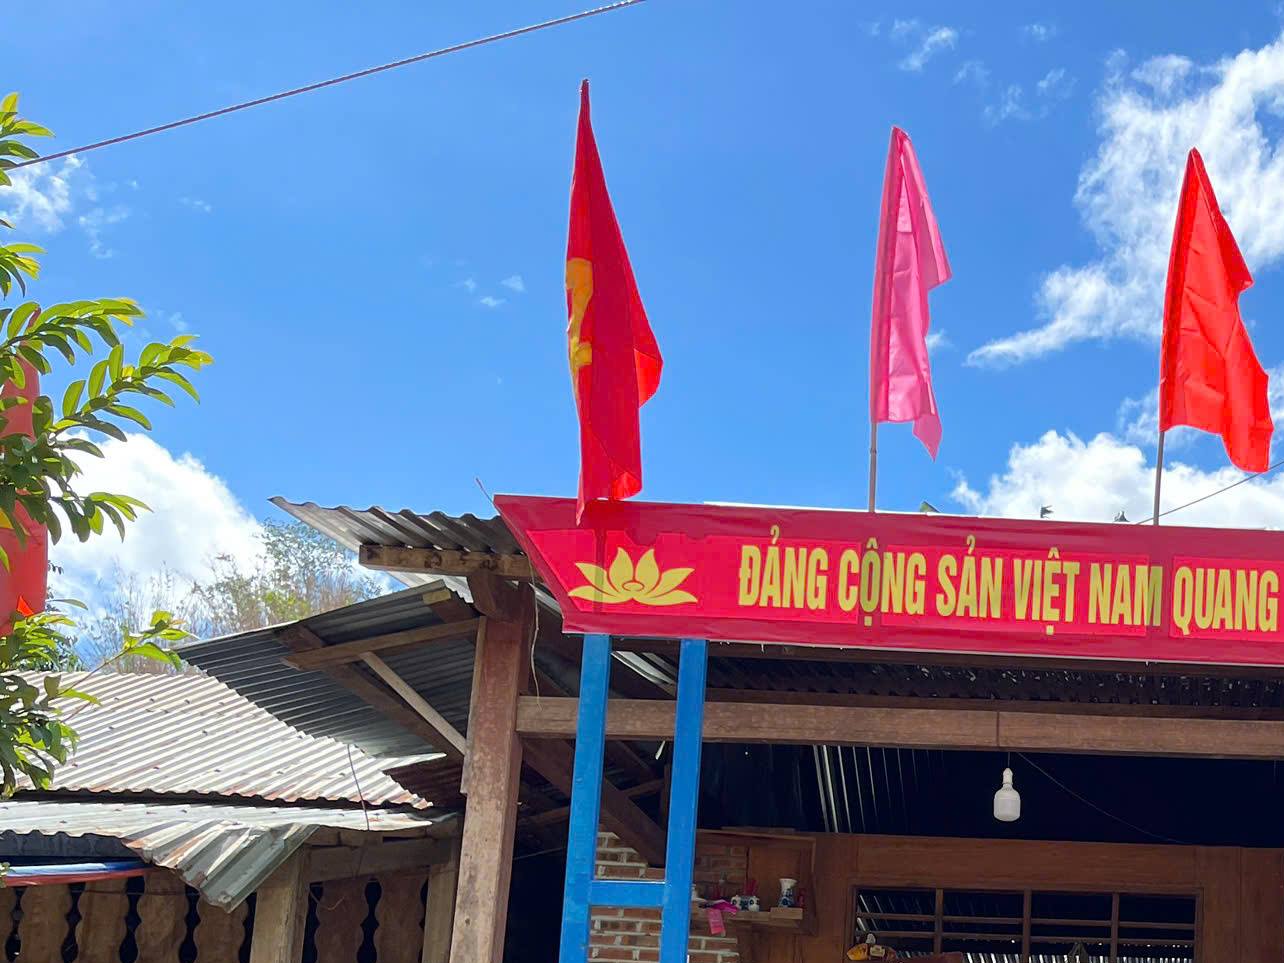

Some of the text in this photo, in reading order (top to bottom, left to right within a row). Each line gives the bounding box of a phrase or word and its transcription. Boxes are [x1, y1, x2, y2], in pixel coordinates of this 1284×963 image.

[739, 525, 829, 610] ĐẢNG
[837, 538, 927, 627] CỘNG
[936, 535, 1003, 619] SẢN
[1013, 547, 1081, 636] VIỆT
[1088, 563, 1163, 627] NAM
[1172, 566, 1279, 636] QUANG
